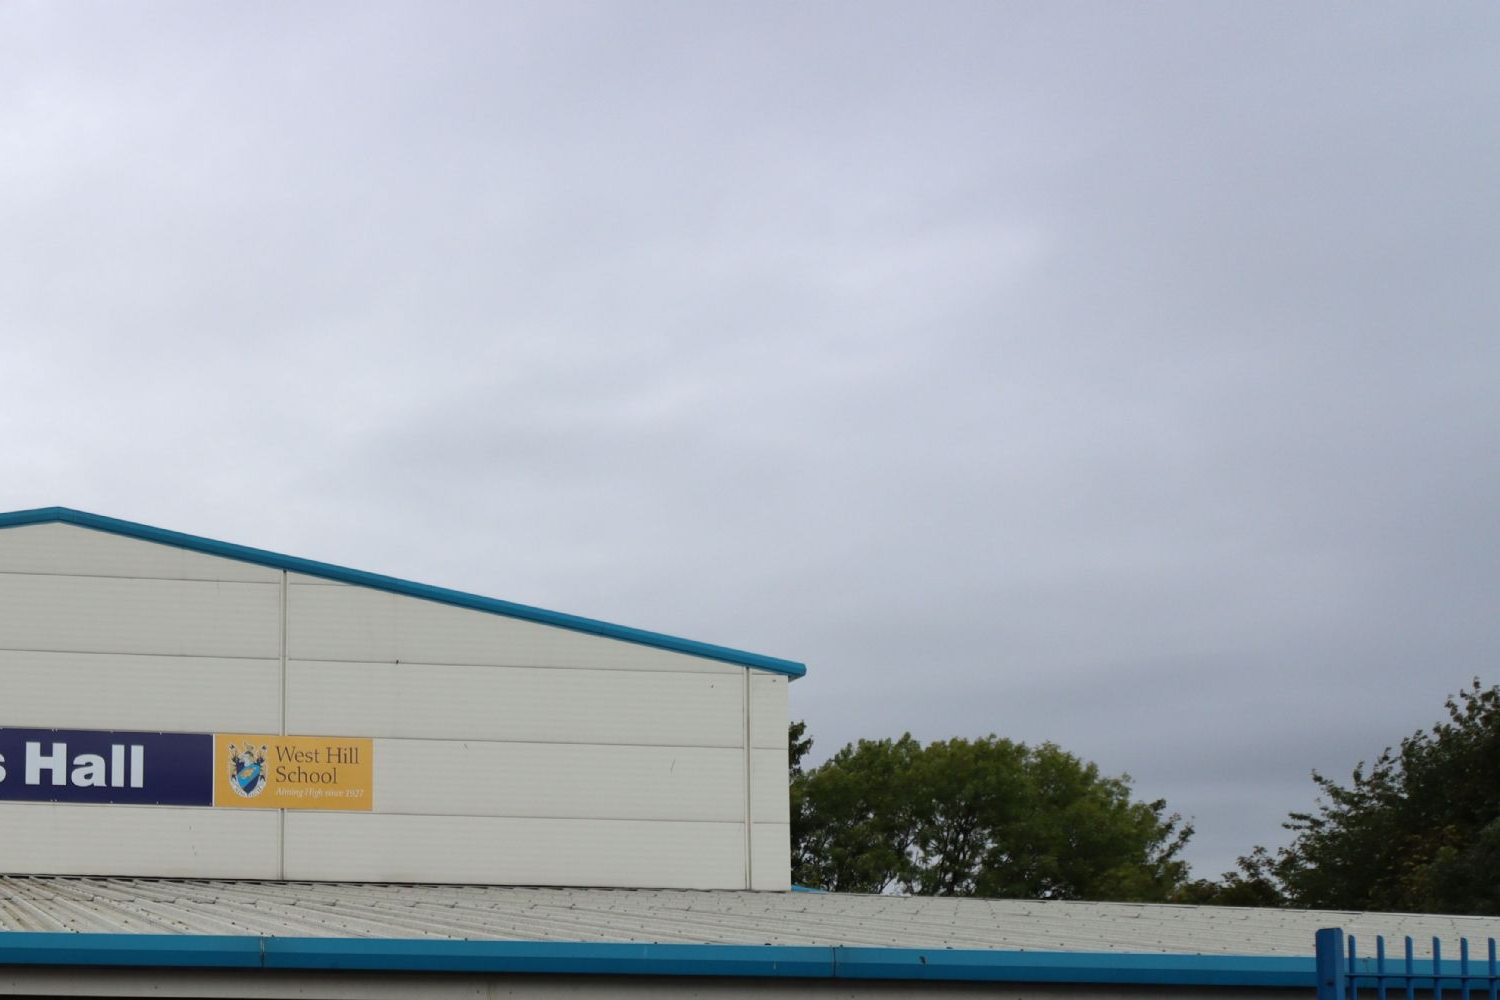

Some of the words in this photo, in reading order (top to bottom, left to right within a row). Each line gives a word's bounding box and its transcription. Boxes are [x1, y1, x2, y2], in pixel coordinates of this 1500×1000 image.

[275, 745, 320, 763] West
[326, 746, 360, 764] Hill
[25, 741, 144, 788] Hall
[275, 766, 338, 784] School
[304, 787, 323, 799] High
